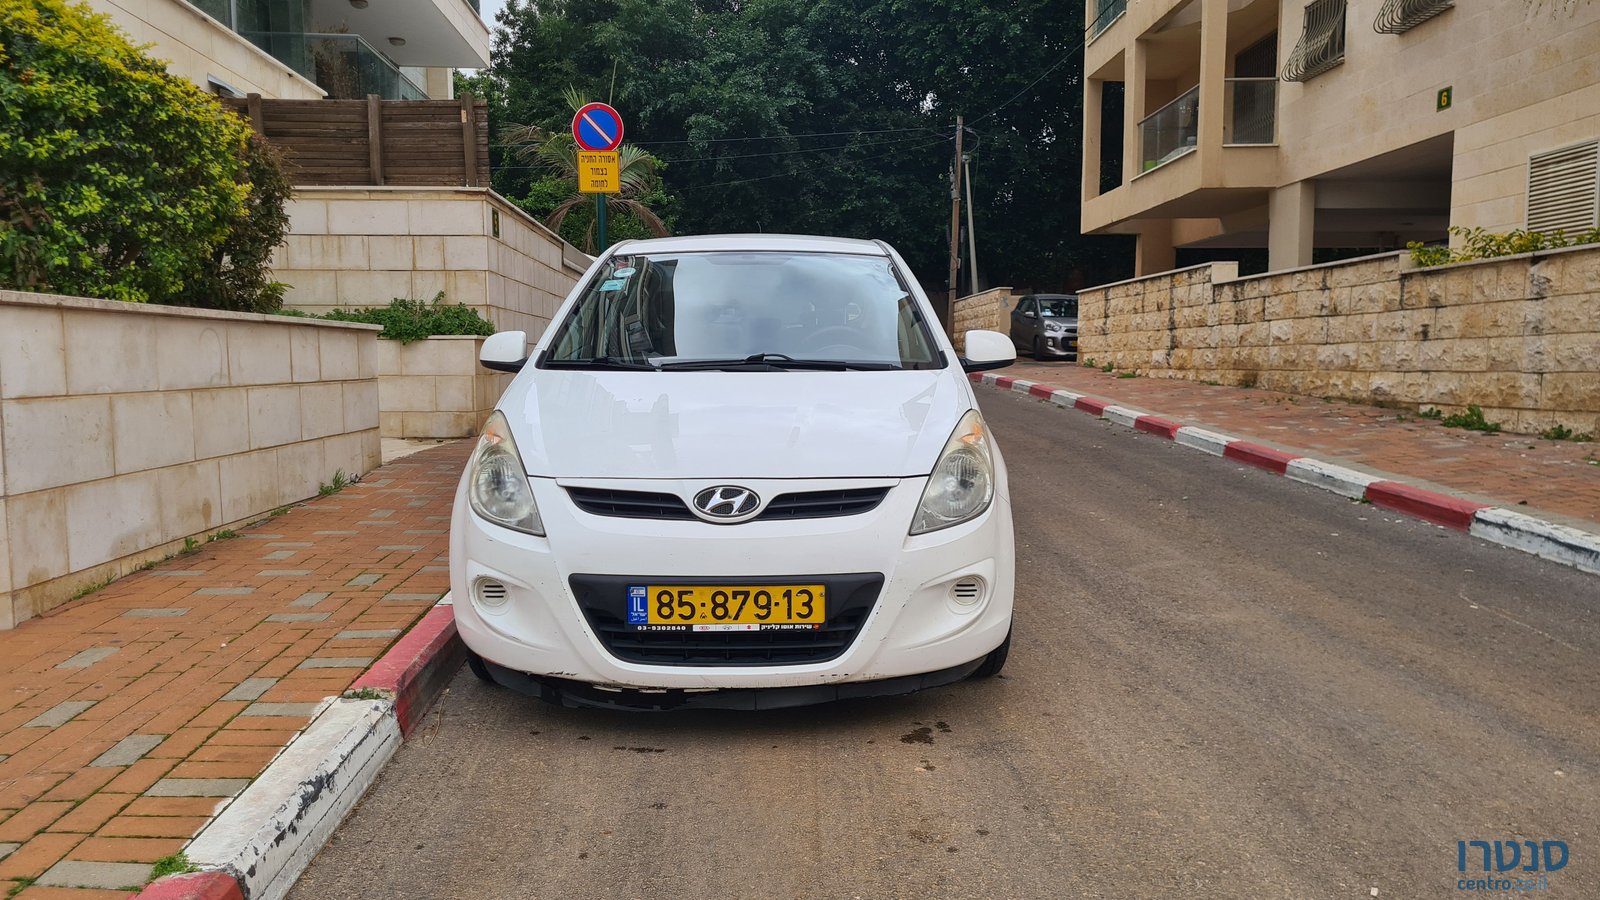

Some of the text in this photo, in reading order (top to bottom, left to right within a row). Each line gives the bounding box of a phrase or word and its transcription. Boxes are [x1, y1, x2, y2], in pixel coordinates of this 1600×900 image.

[1441, 91, 1447, 106] 6
[598, 155, 616, 163] אסורה
[590, 167, 608, 176] בצמוד
[633, 597, 644, 612] IL
